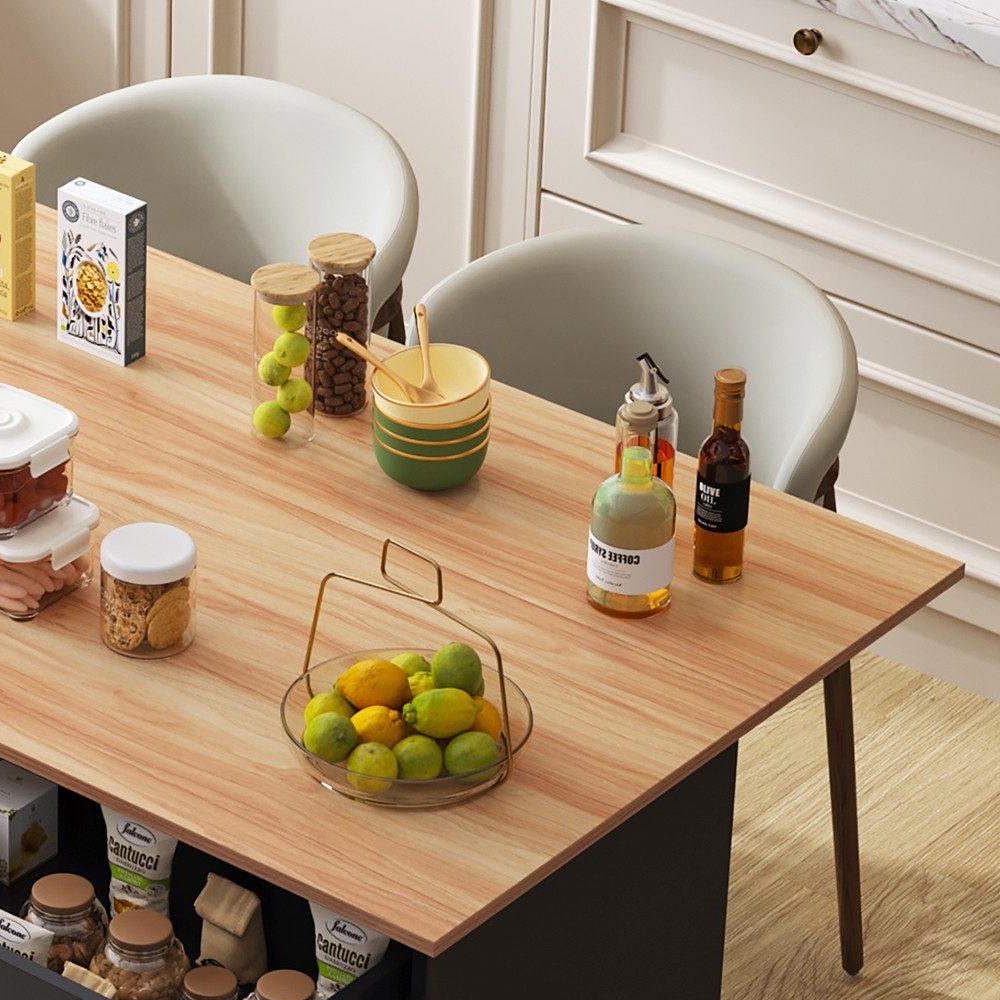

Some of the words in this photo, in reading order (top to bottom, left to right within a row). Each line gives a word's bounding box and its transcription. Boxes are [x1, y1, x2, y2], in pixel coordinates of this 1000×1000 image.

[699, 481, 720, 498] OLIVE
[701, 493, 717, 505] OIL
[122, 822, 152, 844] falcone
[109, 836, 160, 871] Cantucci
[331, 920, 363, 941] falcone
[317, 933, 371, 969] Cantucci
